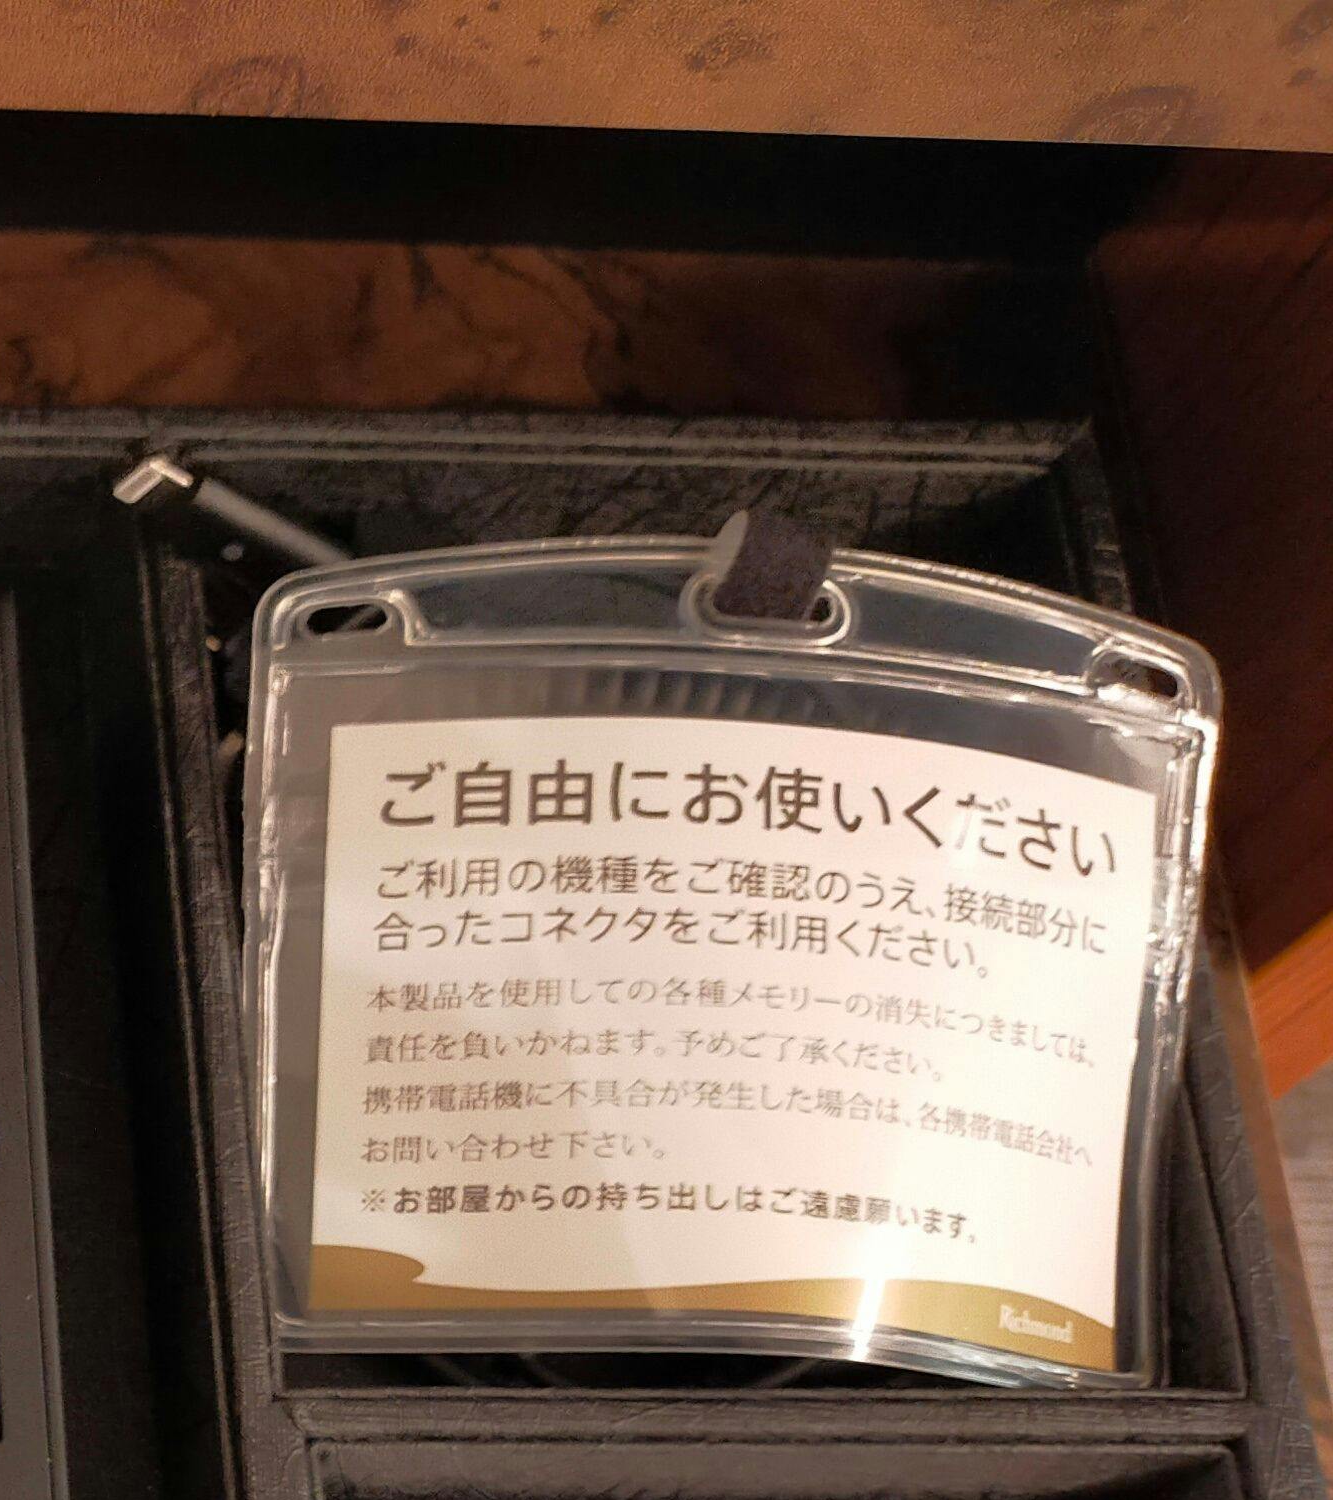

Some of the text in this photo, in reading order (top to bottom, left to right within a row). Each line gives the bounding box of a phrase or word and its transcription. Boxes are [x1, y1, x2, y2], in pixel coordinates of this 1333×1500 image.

[380, 758, 1116, 878] ご自由にお使いください
[373, 906, 989, 978] 合ったコネクタをご利用ください。
[361, 1131, 666, 1164] お問い合わせ下さい。
